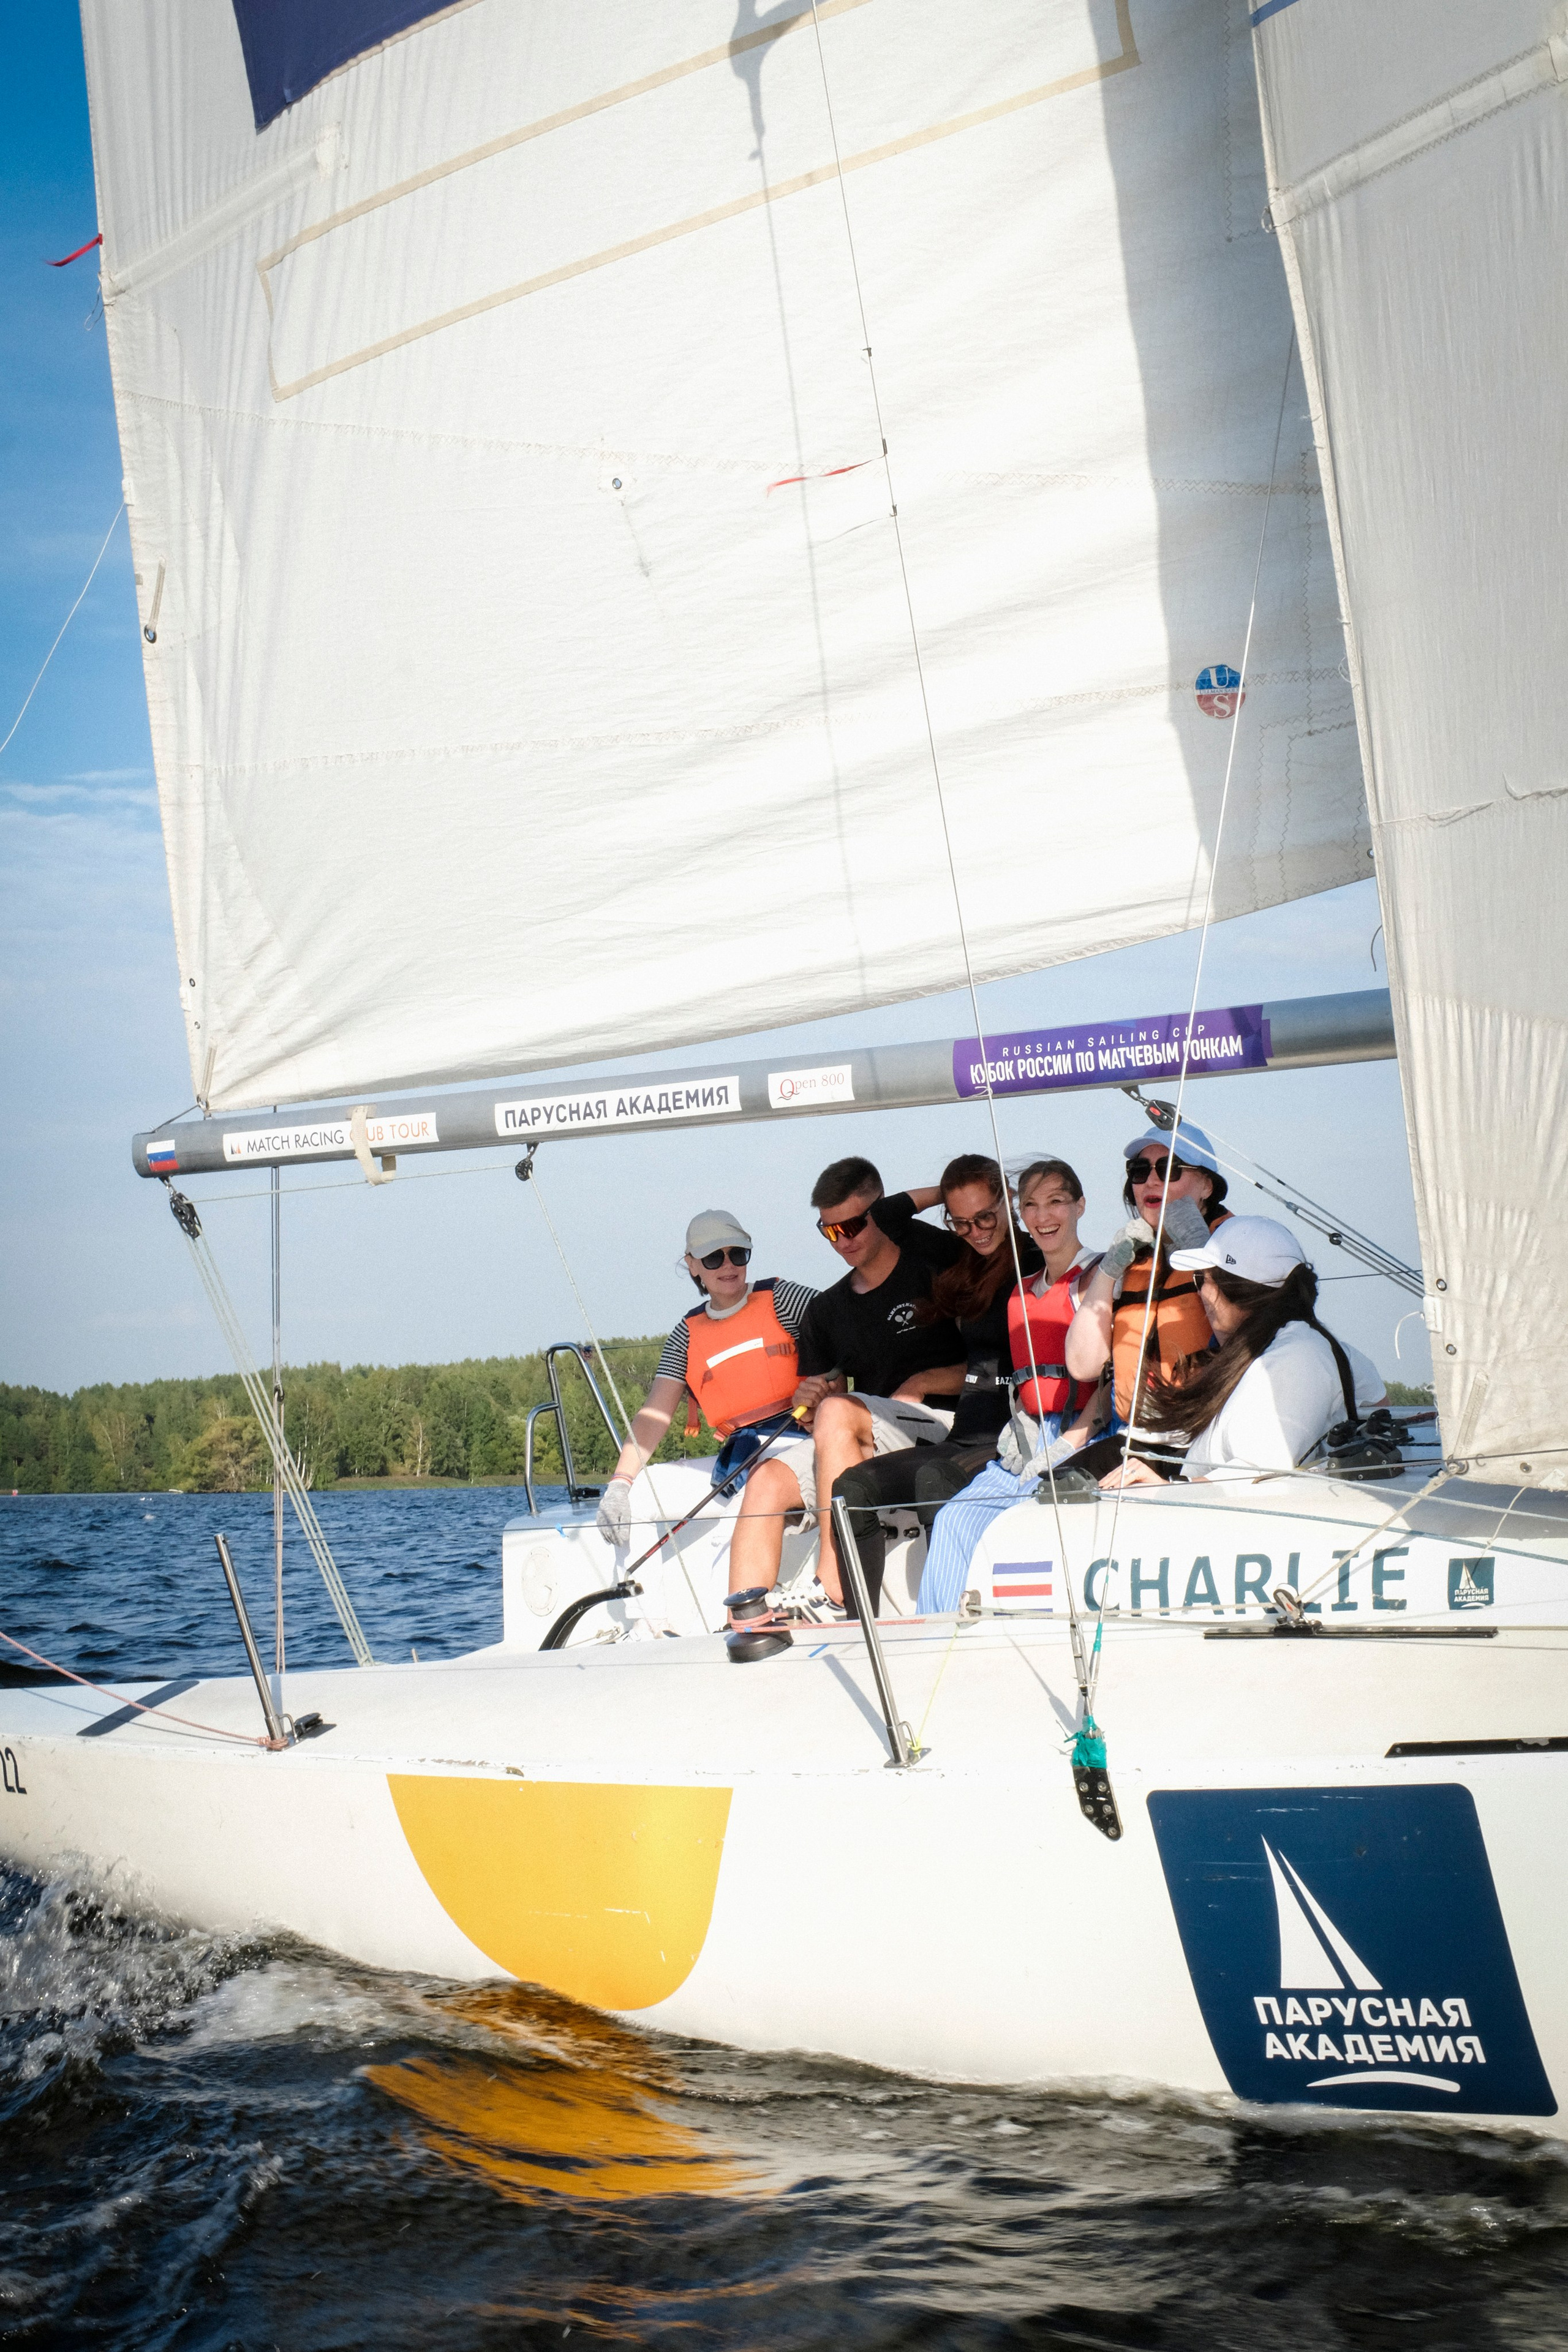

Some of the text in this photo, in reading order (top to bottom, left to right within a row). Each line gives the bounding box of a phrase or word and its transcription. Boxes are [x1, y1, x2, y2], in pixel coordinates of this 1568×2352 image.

[1002, 1039, 1074, 1057] RUSSIAN
[1088, 1030, 1159, 1047] SAILING
[970, 1060, 1016, 1084] КУБОК
[1017, 1054, 1073, 1079] РОССИИ
[1075, 1051, 1095, 1072] ПО
[1098, 1041, 1180, 1071] МАТЧЕВЫМ
[821, 1072, 845, 1087] 800
[505, 1085, 729, 1128] ПАРУСНАЯ АКАДЕМИЯ
[247, 1134, 290, 1153] MATCH
[295, 1129, 344, 1148] RACING
[389, 1121, 430, 1139] TOUR
[1083, 1547, 1410, 1617] CHARLIE
[1253, 1996, 1472, 2027] ПАРУСНАЯ
[1265, 2032, 1487, 2064] АКАДЕМИЯ
